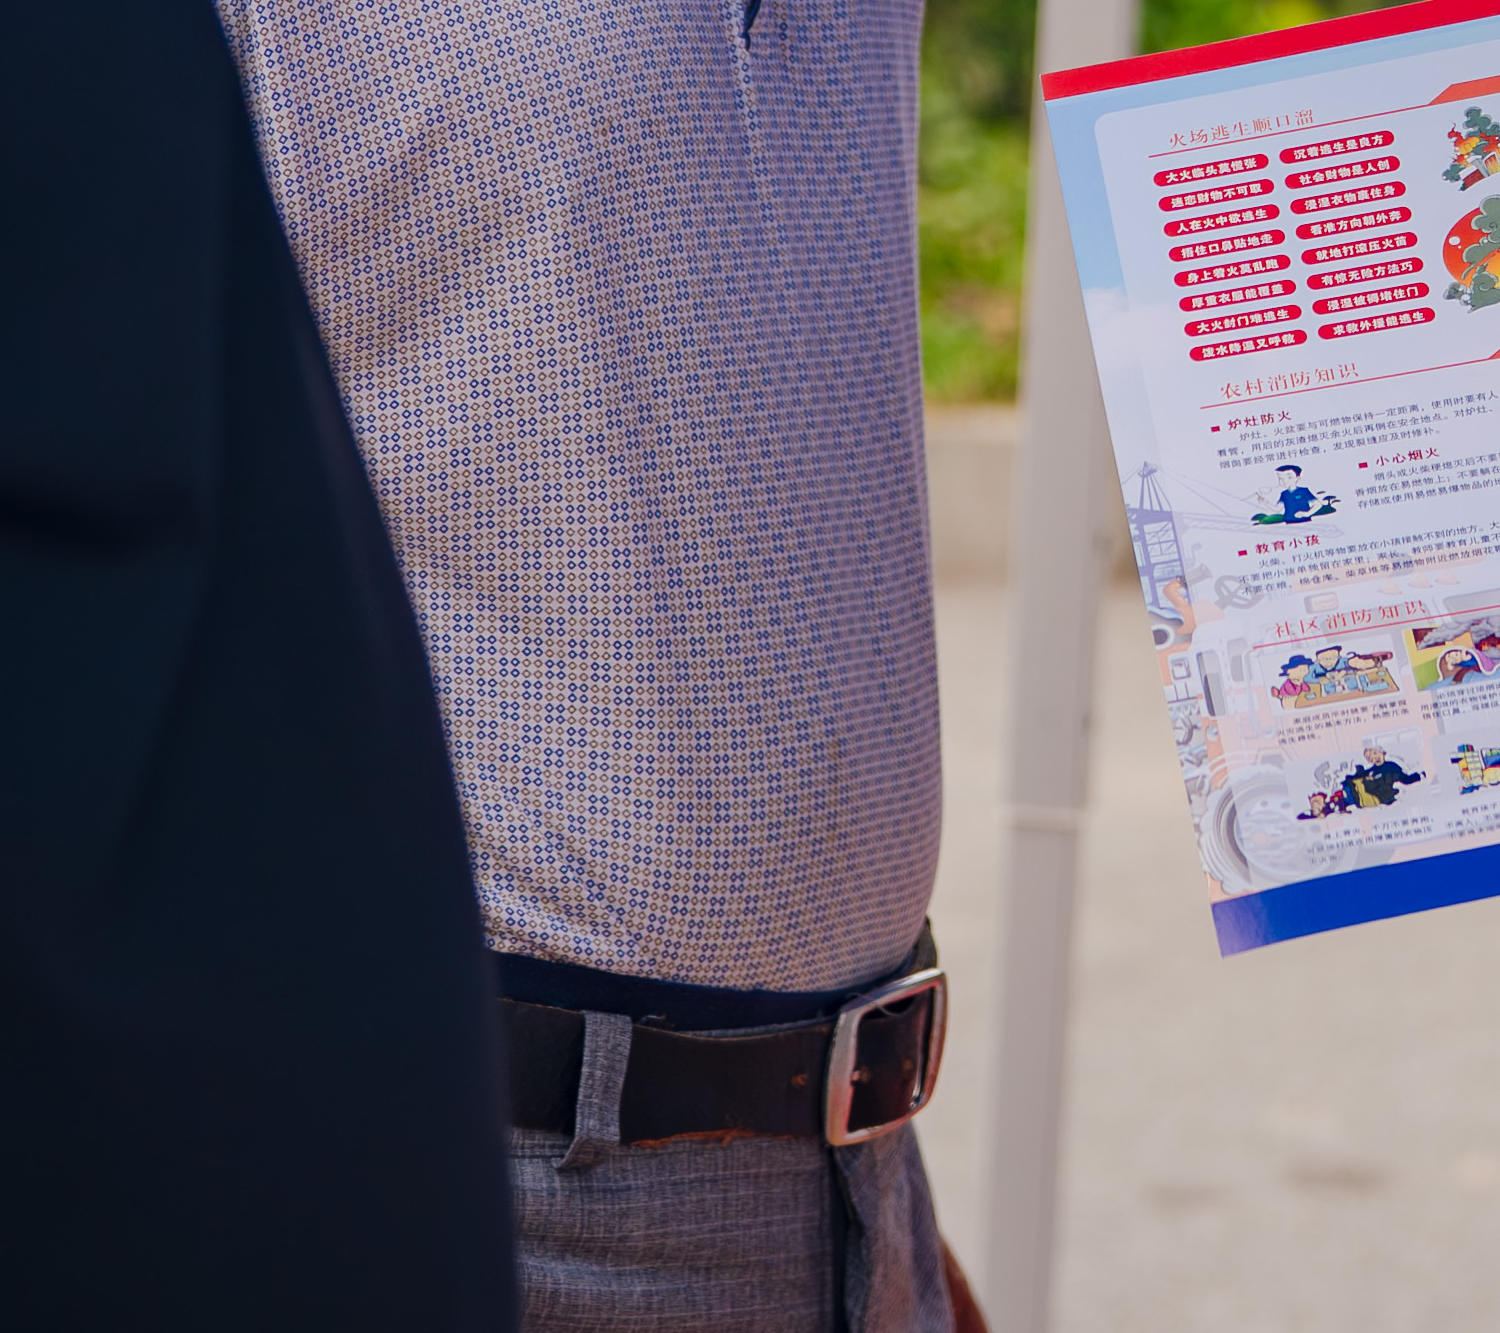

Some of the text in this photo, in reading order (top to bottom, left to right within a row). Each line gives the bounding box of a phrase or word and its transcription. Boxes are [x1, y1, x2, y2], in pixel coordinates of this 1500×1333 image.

[1169, 109, 1314, 148] 火场逃生顺口溜
[1294, 134, 1384, 160] 沉着逃生是良方
[1165, 157, 1257, 184] 大火临头莫慌张
[1299, 160, 1390, 185] 社会财物是人创
[1171, 182, 1263, 209] 迷恋财物不可取
[1176, 208, 1268, 234] 人在火中欲逃生
[1310, 210, 1402, 236] 看准方向朝外奔
[1181, 233, 1273, 259] 捂住口鼻贴地走
[1315, 235, 1407, 261] 就地打滚压火苗
[1187, 258, 1279, 284] 身上着火莫乱跑
[1321, 261, 1413, 287] 有惊无险方法巧
[1191, 283, 1284, 309] 厚重衣服能覆盖
[1196, 308, 1290, 334] 大火封门难逃生
[1333, 310, 1425, 336] 求救外援能逃生
[1202, 333, 1295, 359] 泼水降温又呼救
[1220, 362, 1360, 399] 农村消防知识
[1227, 410, 1292, 431] 炉灶防火
[1375, 447, 1440, 467] 小心烟火
[1255, 534, 1320, 555] 教育小孩
[1276, 600, 1425, 638] 社区消防知识
